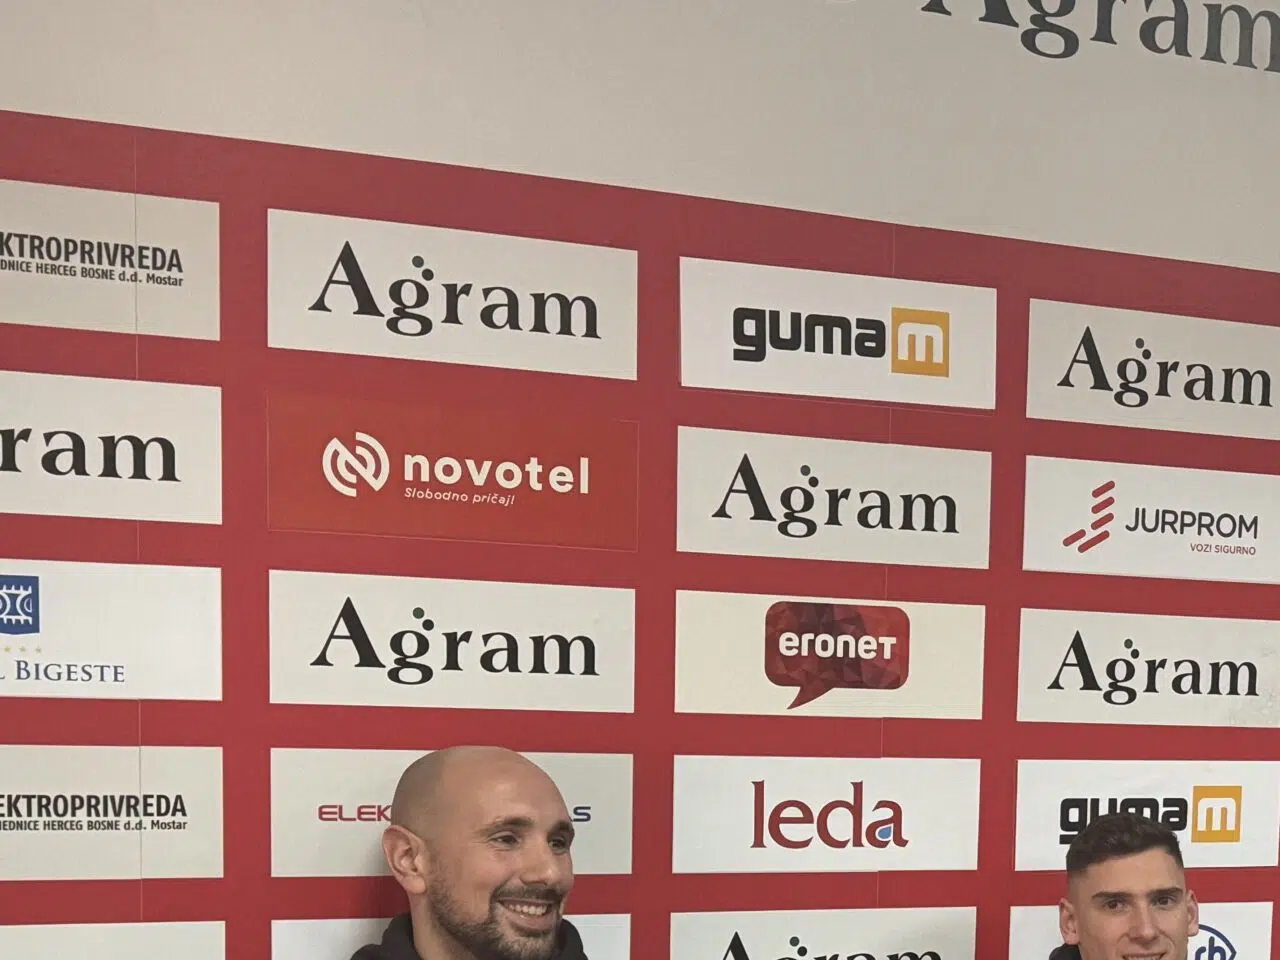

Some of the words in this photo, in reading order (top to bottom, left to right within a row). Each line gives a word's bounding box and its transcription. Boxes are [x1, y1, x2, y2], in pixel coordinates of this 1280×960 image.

[35, 262, 77, 277] HERCEG
[80, 266, 115, 281] BOSNE
[146, 272, 183, 287] Mostar
[308, 240, 602, 336] Agram
[1056, 325, 1274, 408] Agram
[404, 454, 588, 494] novotel
[404, 487, 468, 503] Slobodno
[472, 493, 515, 506] pričaj!
[711, 452, 960, 538] Agram
[1125, 507, 1259, 540] JURPROM
[1190, 542, 1212, 553] VOZI
[1214, 544, 1256, 556] SIGURNO
[309, 596, 601, 685] Agram
[778, 630, 898, 661] eronet
[15, 660, 125, 682] BIGESTE
[1047, 630, 1260, 706] Agram
[43, 820, 83, 831] HERCEG
[87, 820, 120, 831] BOSNE
[150, 820, 187, 831] Mostar
[750, 779, 909, 849] leda
